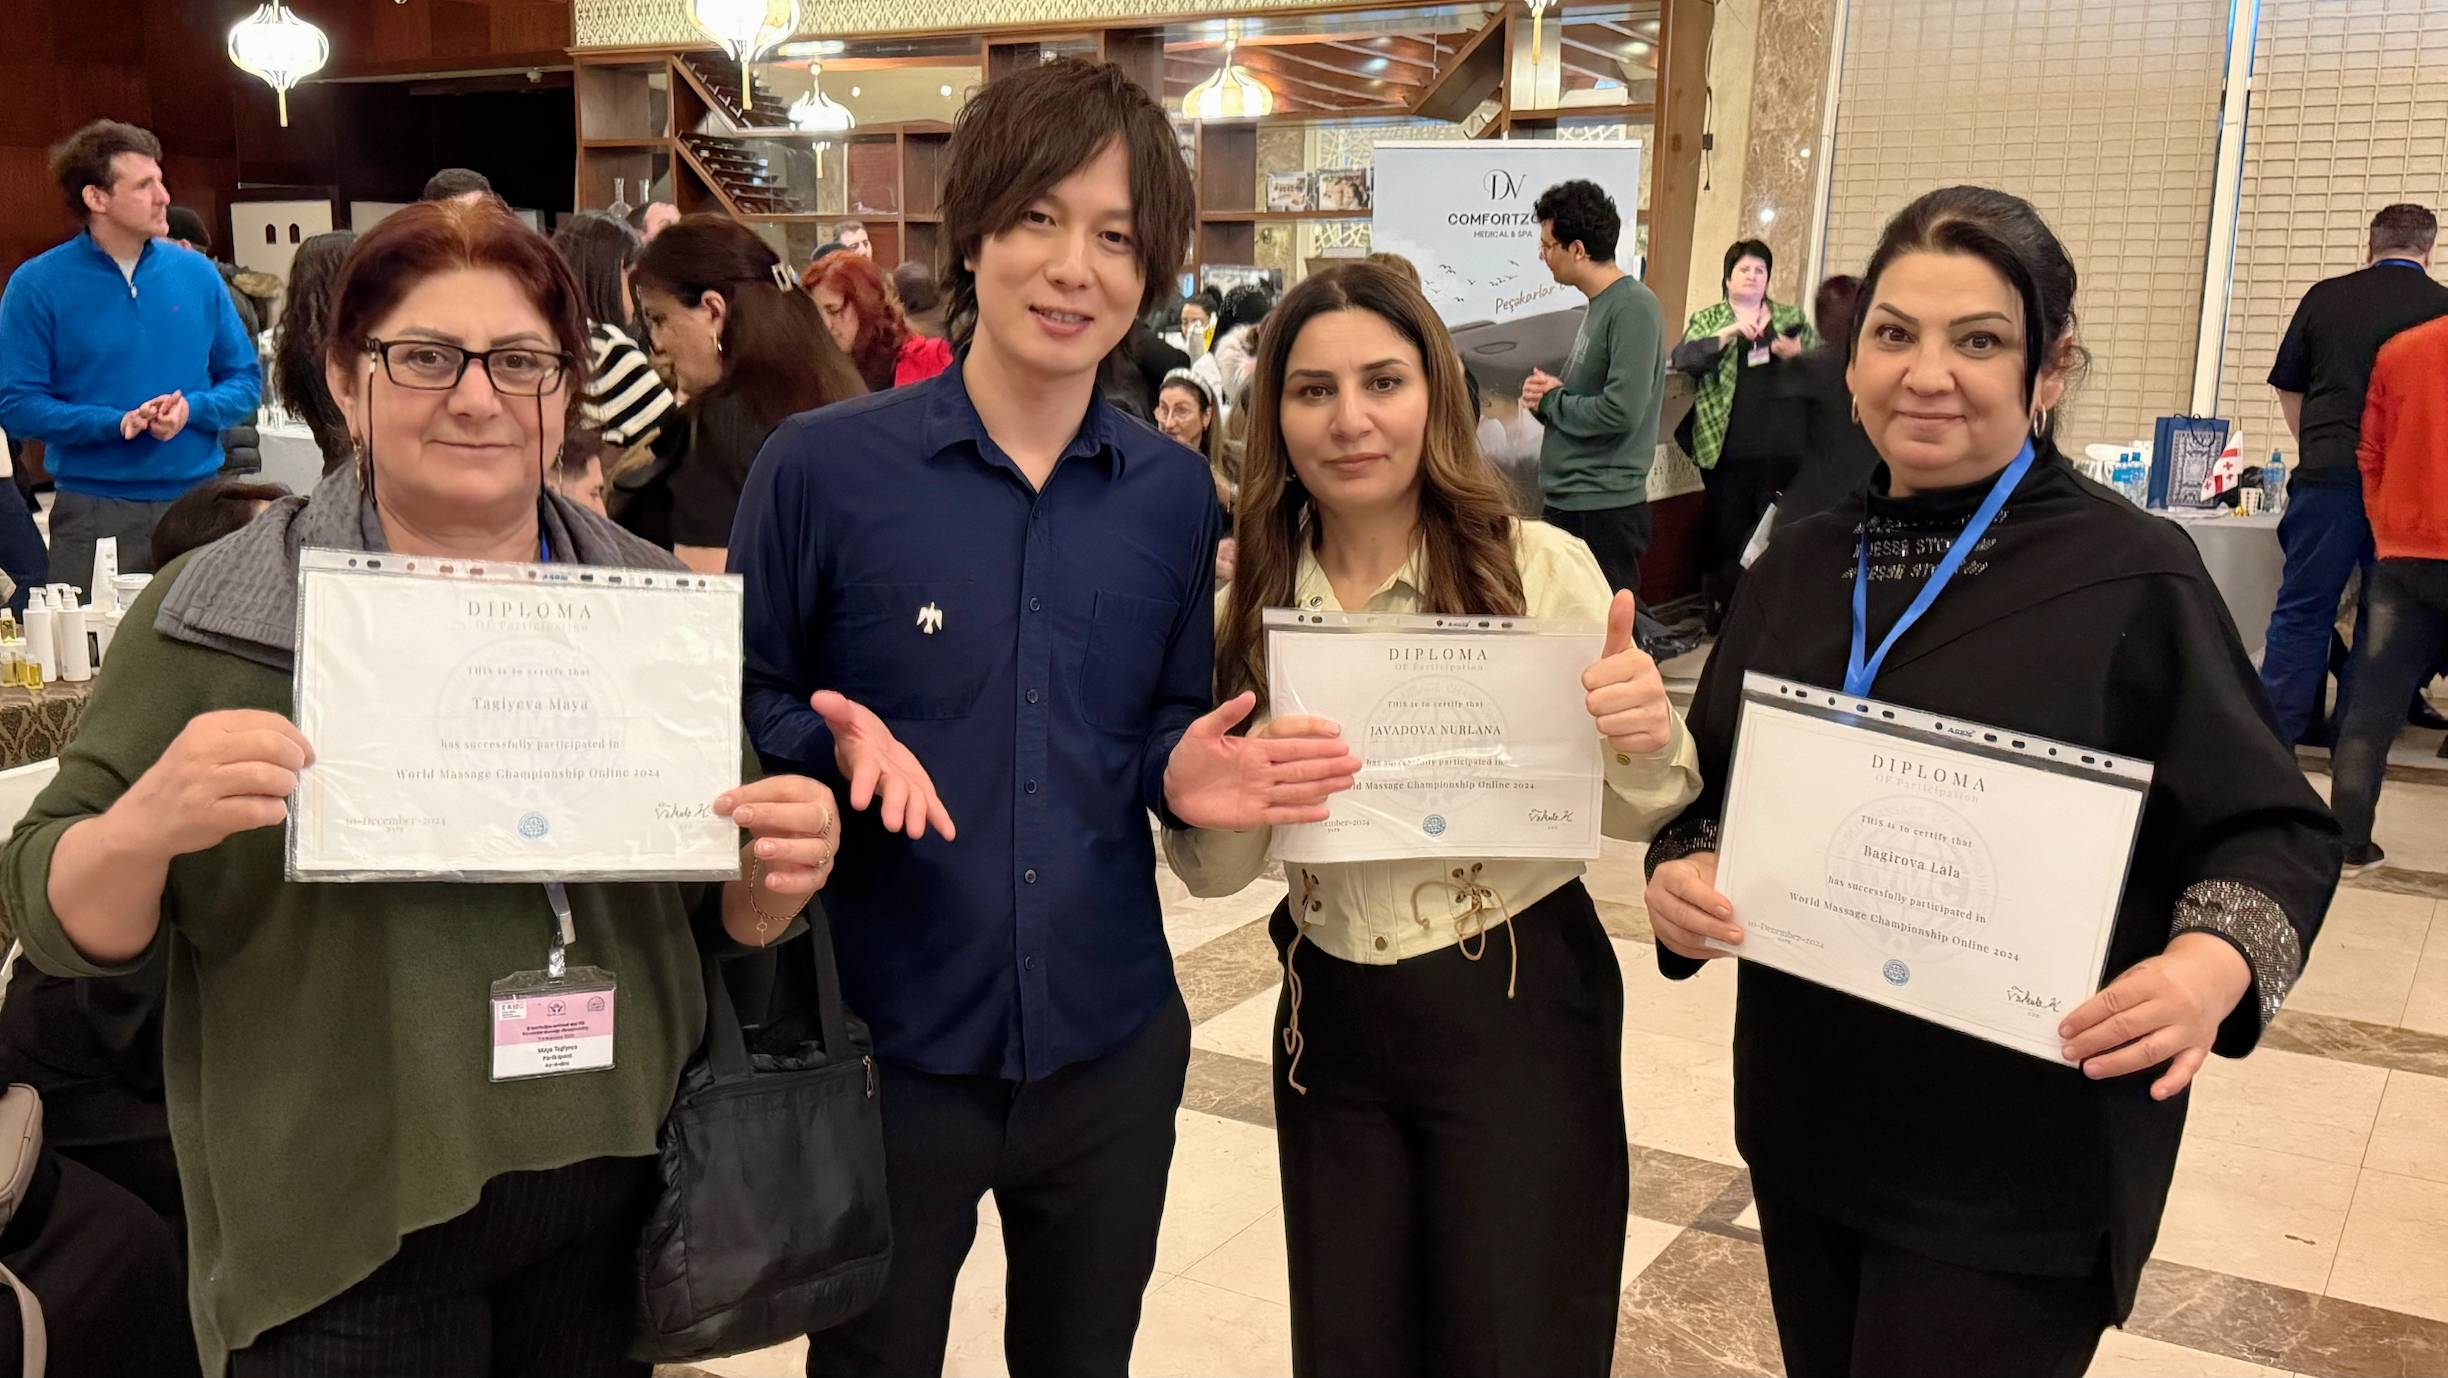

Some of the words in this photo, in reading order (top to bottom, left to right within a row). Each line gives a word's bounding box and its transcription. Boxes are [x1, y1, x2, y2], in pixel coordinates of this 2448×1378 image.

[1473, 230, 1509, 238] MEDICAL
[1517, 230, 1533, 238] SPA
[468, 600, 591, 620] DIPLOMA
[1389, 647, 1488, 661] DIPLOMA
[472, 696, 542, 713] Tagiyeva
[549, 697, 588, 713] Maya
[1370, 725, 1436, 738] JAVADOVA
[1440, 724, 1501, 737] NURLANA
[440, 739, 460, 750] has
[464, 738, 534, 751] successfully
[536, 738, 605, 751] participated
[609, 738, 621, 749] in
[1439, 757, 1492, 768] participated
[396, 768, 435, 780] World
[439, 769, 492, 782] Massage
[496, 767, 585, 782] Championship
[589, 766, 629, 779] Online
[634, 769, 660, 779] 2024
[1871, 754, 1985, 792] DIPLOMA
[1365, 781, 1404, 791] Massage
[1407, 780, 1475, 791] Championship
[1478, 779, 1510, 789] Online
[1513, 782, 1535, 790] 2024
[1897, 778, 1979, 803] Participation
[1860, 815, 1884, 828] THIS
[1899, 825, 1910, 834] to
[1913, 828, 1948, 843] certify
[1951, 836, 1973, 848] that
[1863, 845, 1925, 871] Bagirova
[1930, 861, 1961, 879] Lala
[1828, 875, 1844, 887] has
[1847, 882, 1907, 904] successfully
[1910, 898, 1973, 921] participated
[1976, 912, 1987, 924] in
[1789, 891, 1820, 908] World
[1823, 900, 1867, 921] Massage
[1870, 914, 1948, 944] Championship
[1952, 935, 1990, 954] Online
[1993, 947, 2020, 963] 2024
